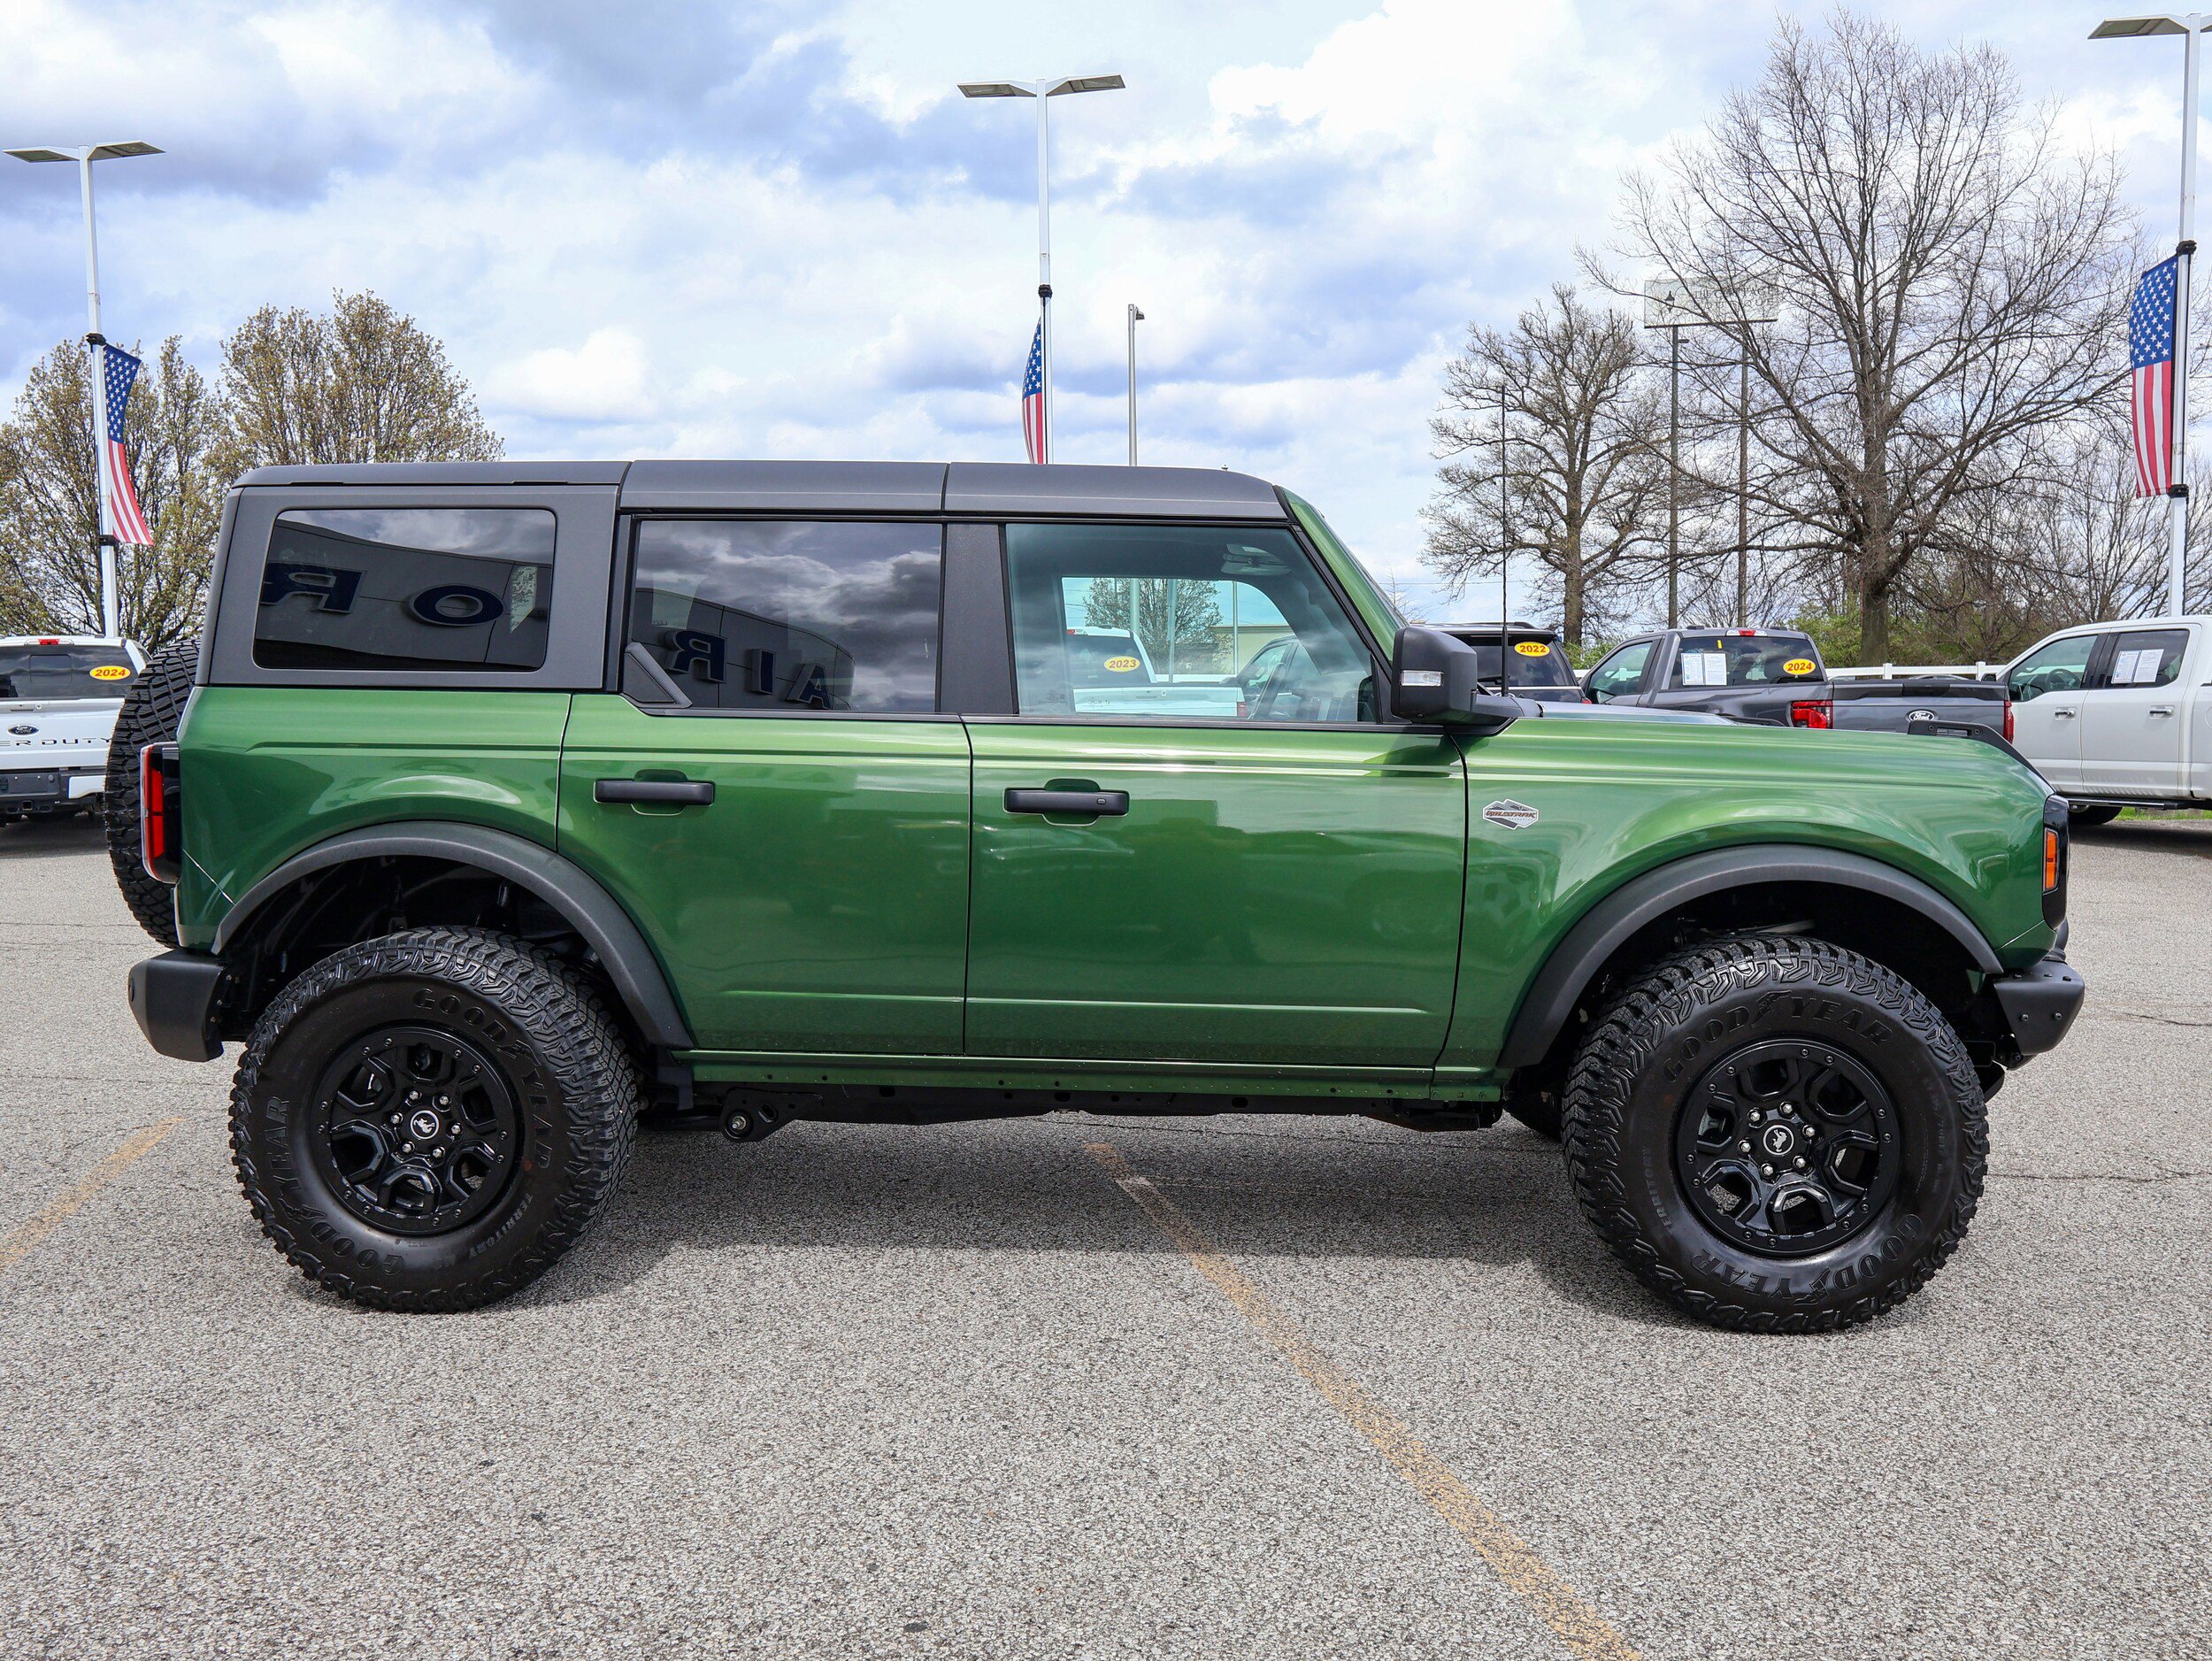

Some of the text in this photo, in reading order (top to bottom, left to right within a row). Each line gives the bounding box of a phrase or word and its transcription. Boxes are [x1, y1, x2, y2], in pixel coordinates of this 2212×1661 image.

[1108, 658, 1137, 669] 2023
[1787, 662, 1812, 672] 2024
[95, 668, 126, 677] 2024
